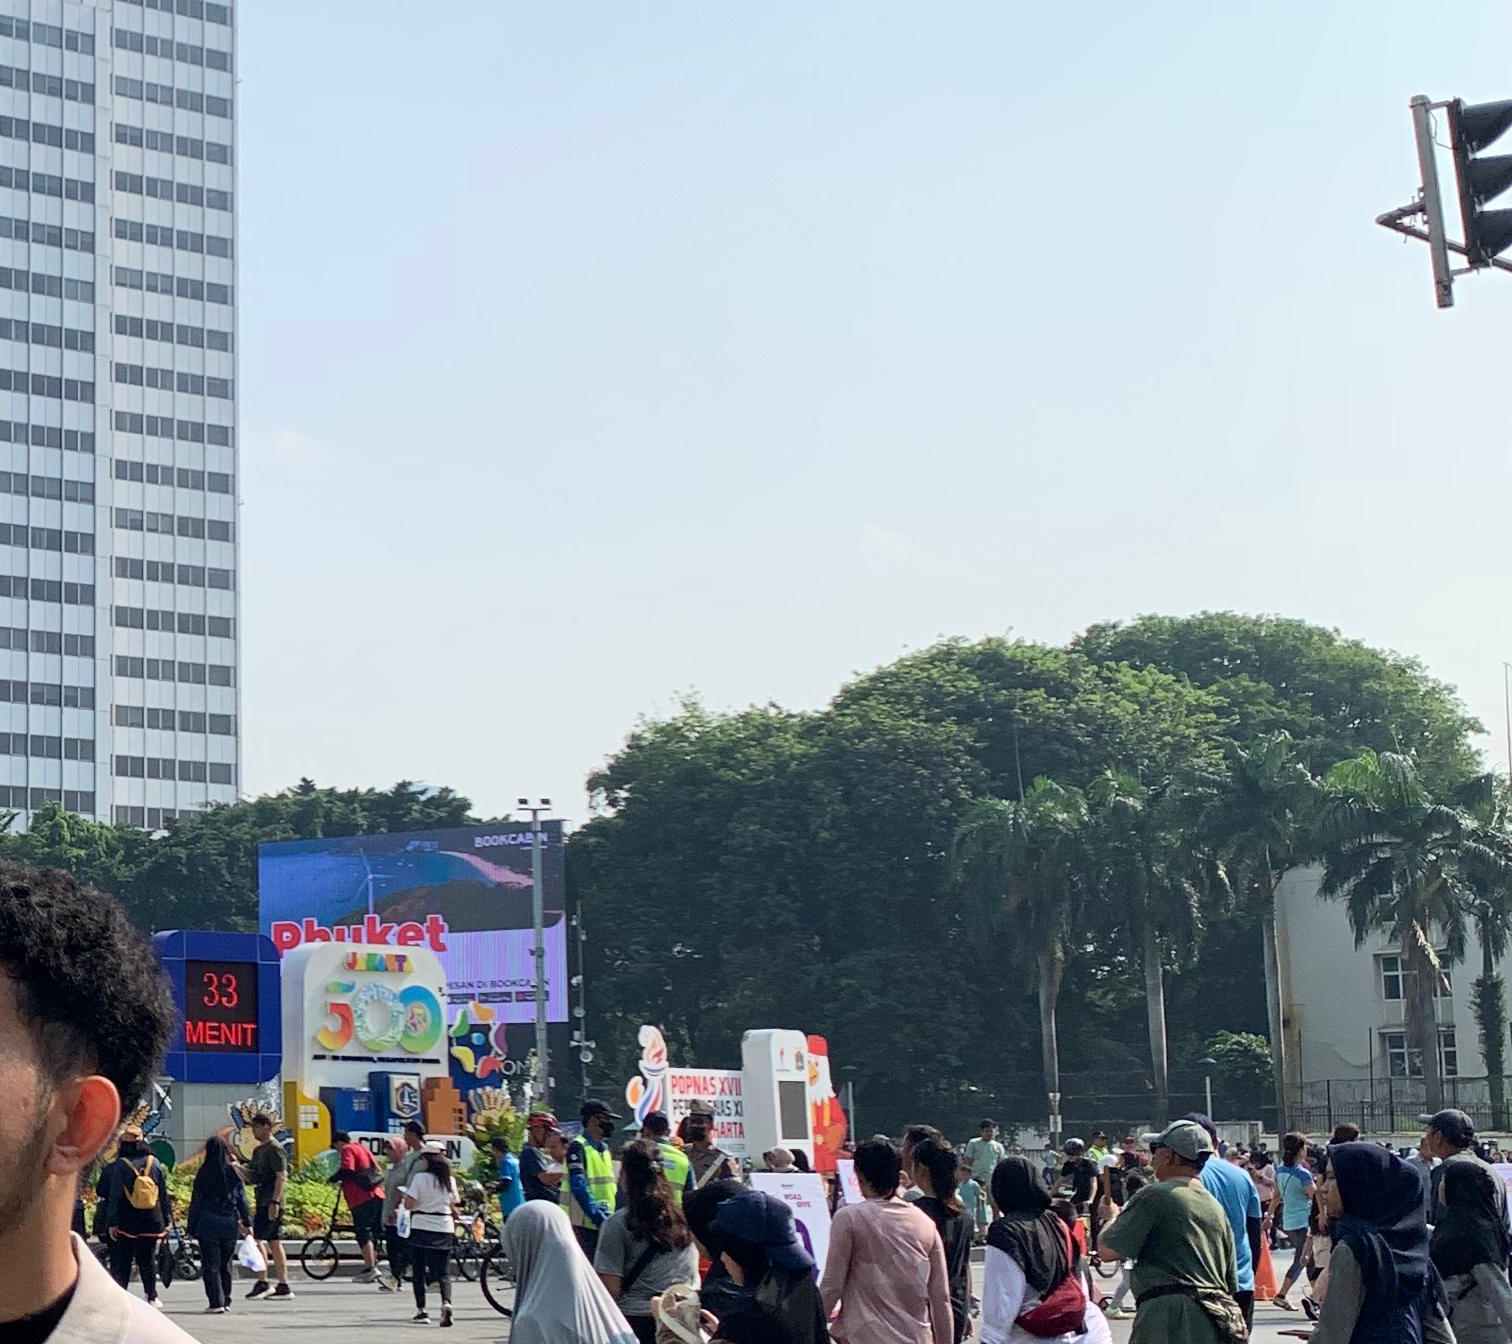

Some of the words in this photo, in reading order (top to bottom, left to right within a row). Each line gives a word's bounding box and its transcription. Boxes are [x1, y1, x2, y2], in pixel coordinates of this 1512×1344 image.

[474, 832, 549, 848] BOOKCABN
[271, 913, 448, 959] Phuket
[203, 972, 238, 1007] 33
[447, 981, 474, 989] ESAN
[490, 978, 549, 988] BOOKCA
[185, 1021, 258, 1046] MENIT
[671, 1075, 716, 1095] POPNAS
